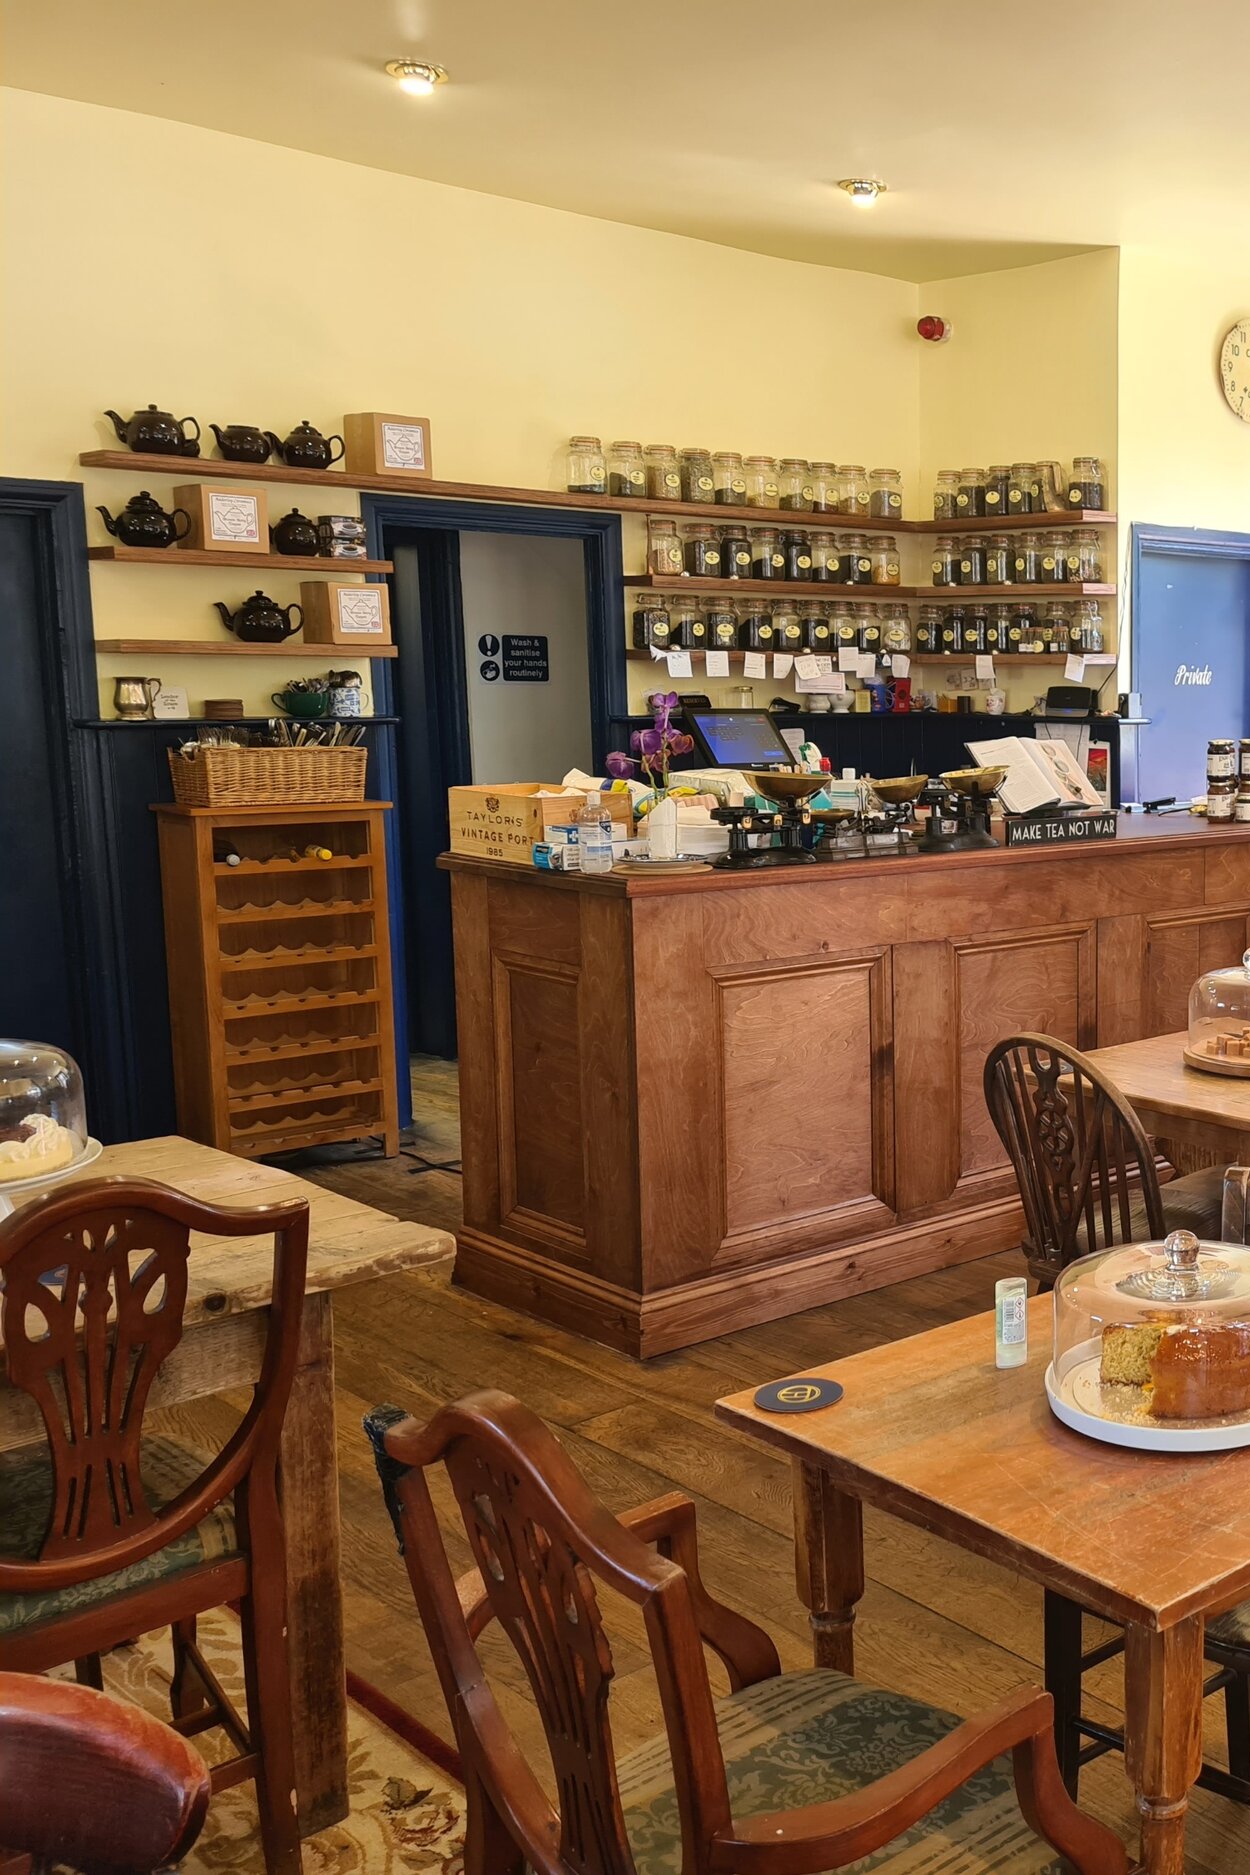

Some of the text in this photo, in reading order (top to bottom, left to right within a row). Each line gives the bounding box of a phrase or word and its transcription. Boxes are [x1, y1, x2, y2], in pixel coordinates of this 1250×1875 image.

[1240, 332, 1246, 343] 11
[1231, 345, 1240, 356] 10
[510, 638, 540, 647] Wash &
[510, 649, 541, 657] sanitise
[504, 659, 547, 668] your hands
[509, 669, 543, 678] routinely
[1174, 664, 1212, 686] Private
[1012, 819, 1115, 840] MAKE TEA NOT WAR
[461, 827, 534, 846] VINTAGE PORT
[486, 847, 503, 857] 1985
